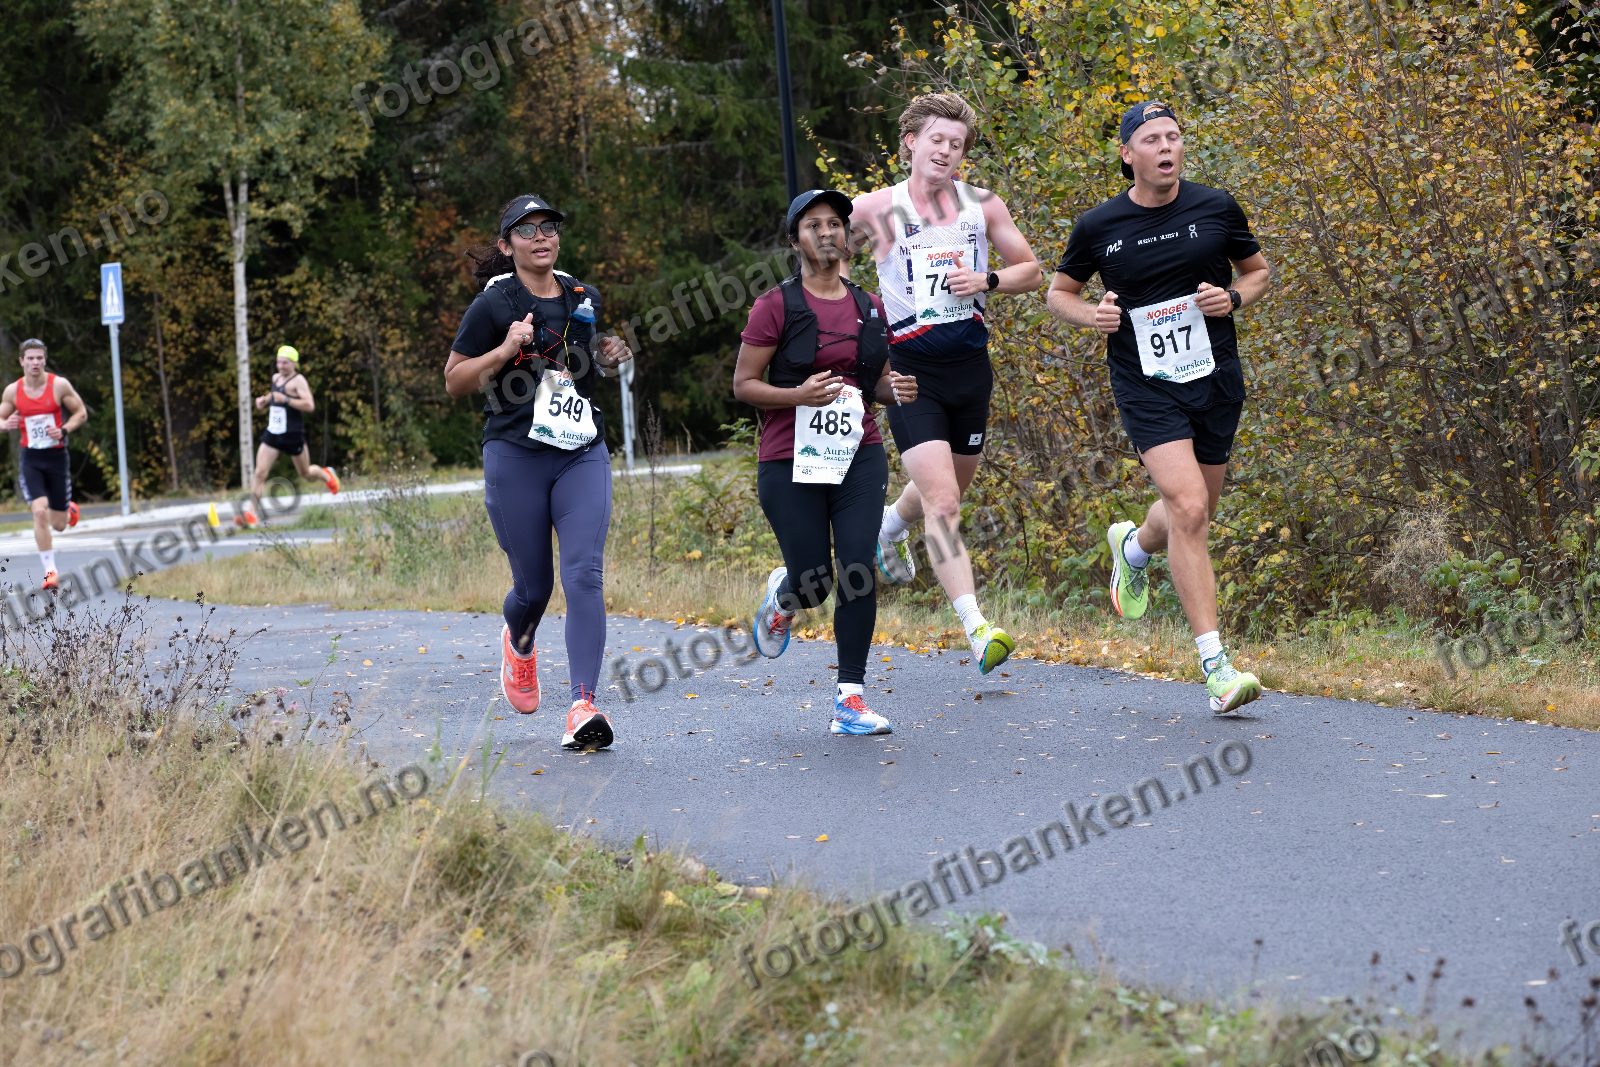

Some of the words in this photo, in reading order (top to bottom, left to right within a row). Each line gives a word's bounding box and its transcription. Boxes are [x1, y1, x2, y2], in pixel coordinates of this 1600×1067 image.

[926, 251, 965, 261] NORGS
[930, 259, 954, 268] LØPE
[1147, 302, 1188, 320] NORGES
[1152, 312, 1183, 326] LØPET
[1150, 325, 1192, 358] 917
[1174, 358, 1212, 375] Aurskog
[548, 392, 584, 423] 549
[809, 410, 852, 436] 485
